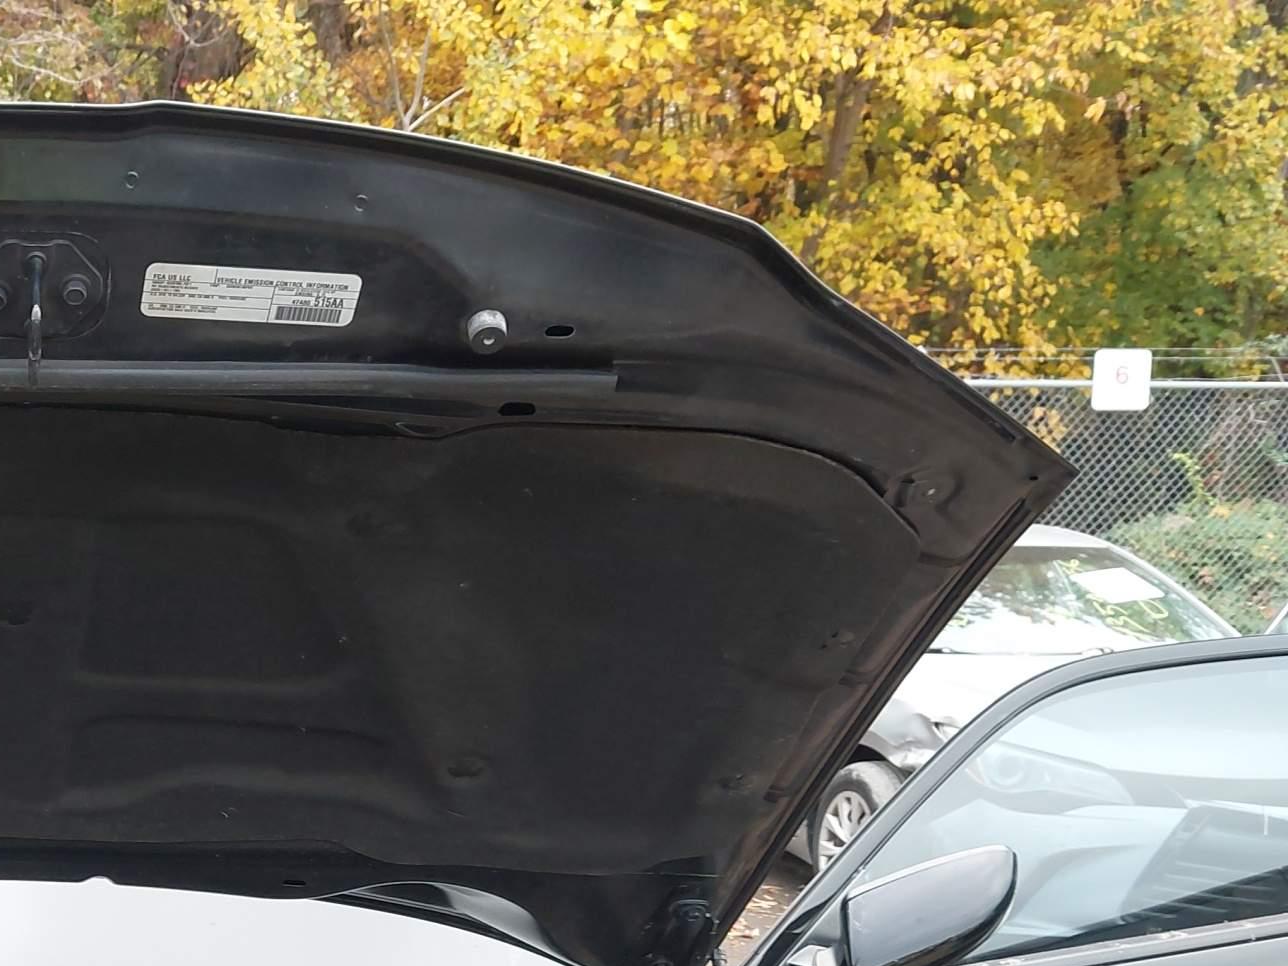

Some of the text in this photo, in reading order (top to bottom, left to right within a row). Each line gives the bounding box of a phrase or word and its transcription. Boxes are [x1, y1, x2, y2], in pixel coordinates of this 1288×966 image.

[217, 277, 242, 285] VEHICLE
[276, 280, 303, 288] CONTROL
[305, 282, 350, 290] INFORMATION
[1115, 365, 1129, 385] 6
